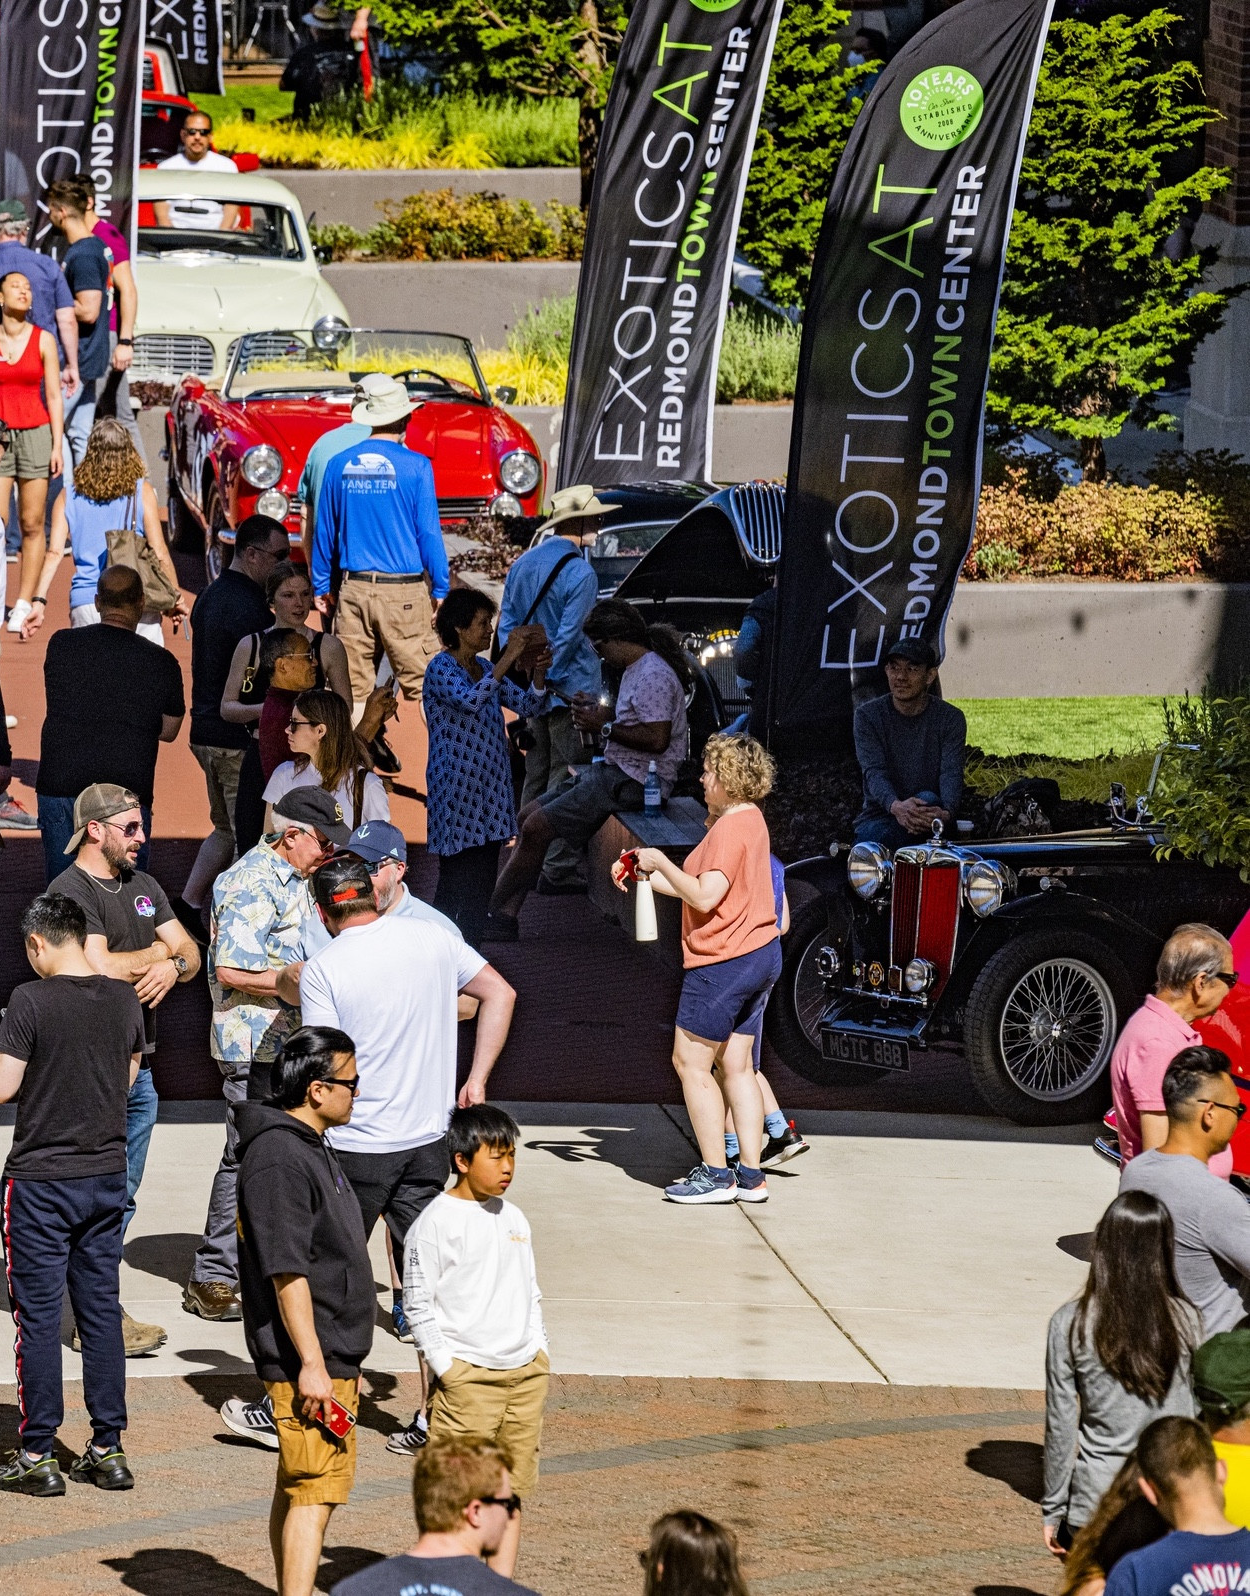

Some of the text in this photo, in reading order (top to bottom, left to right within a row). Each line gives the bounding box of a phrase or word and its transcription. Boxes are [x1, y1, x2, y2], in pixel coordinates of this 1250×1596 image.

[913, 103, 973, 123] ESTABLISHED
[915, 113, 973, 141] ANNIVERSARY
[374, 480, 397, 490] TEN
[830, 1034, 869, 1061] MGTC
